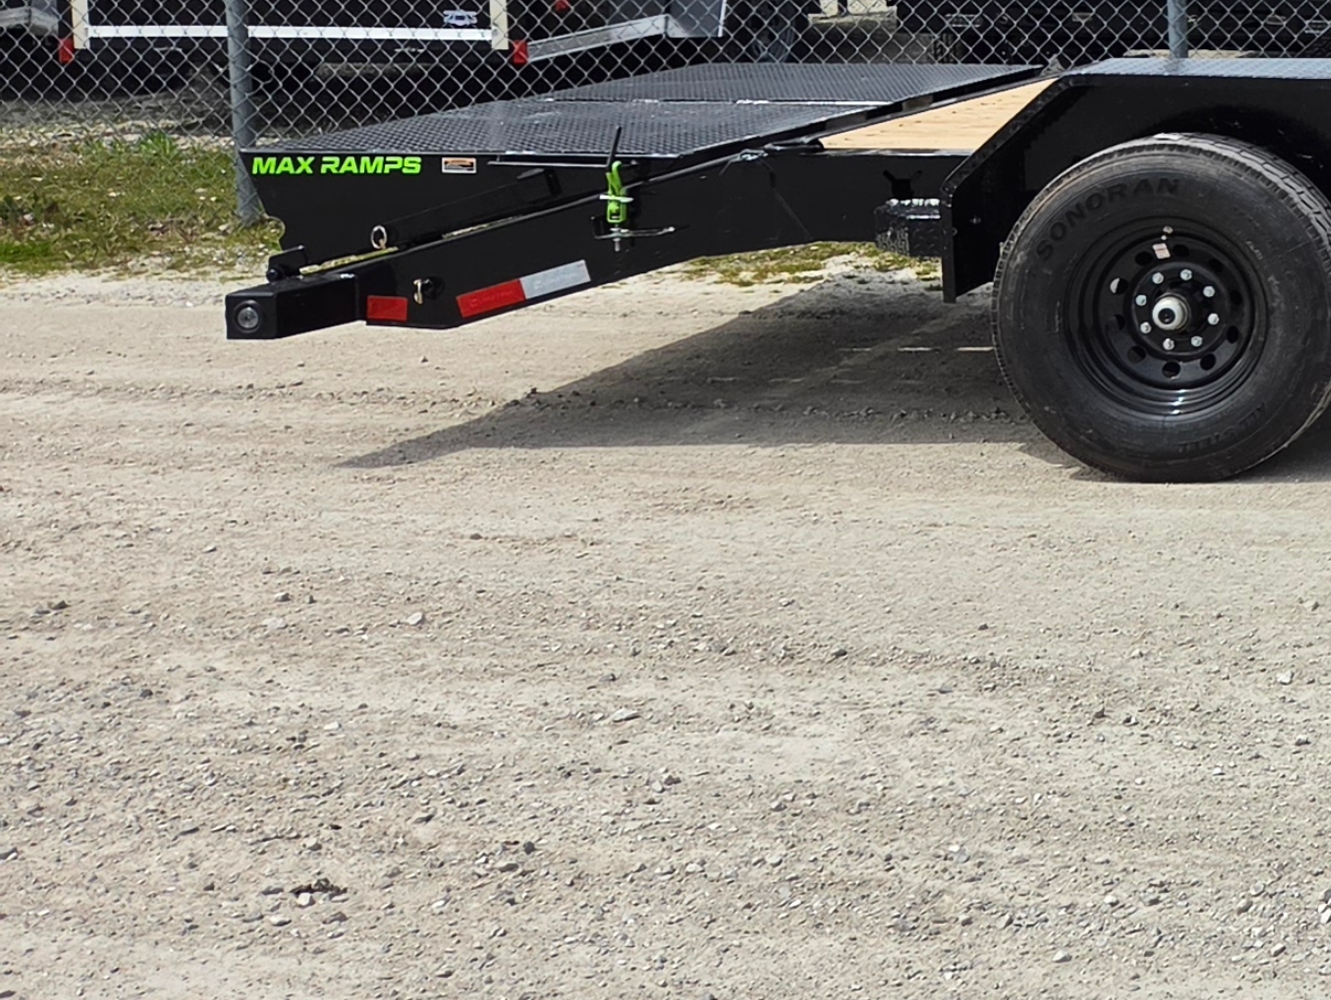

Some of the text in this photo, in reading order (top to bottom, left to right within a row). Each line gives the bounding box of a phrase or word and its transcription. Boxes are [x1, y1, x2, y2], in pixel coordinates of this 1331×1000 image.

[252, 156, 422, 175] MAX RAMPS
[1036, 177, 1181, 263] SONORAN
